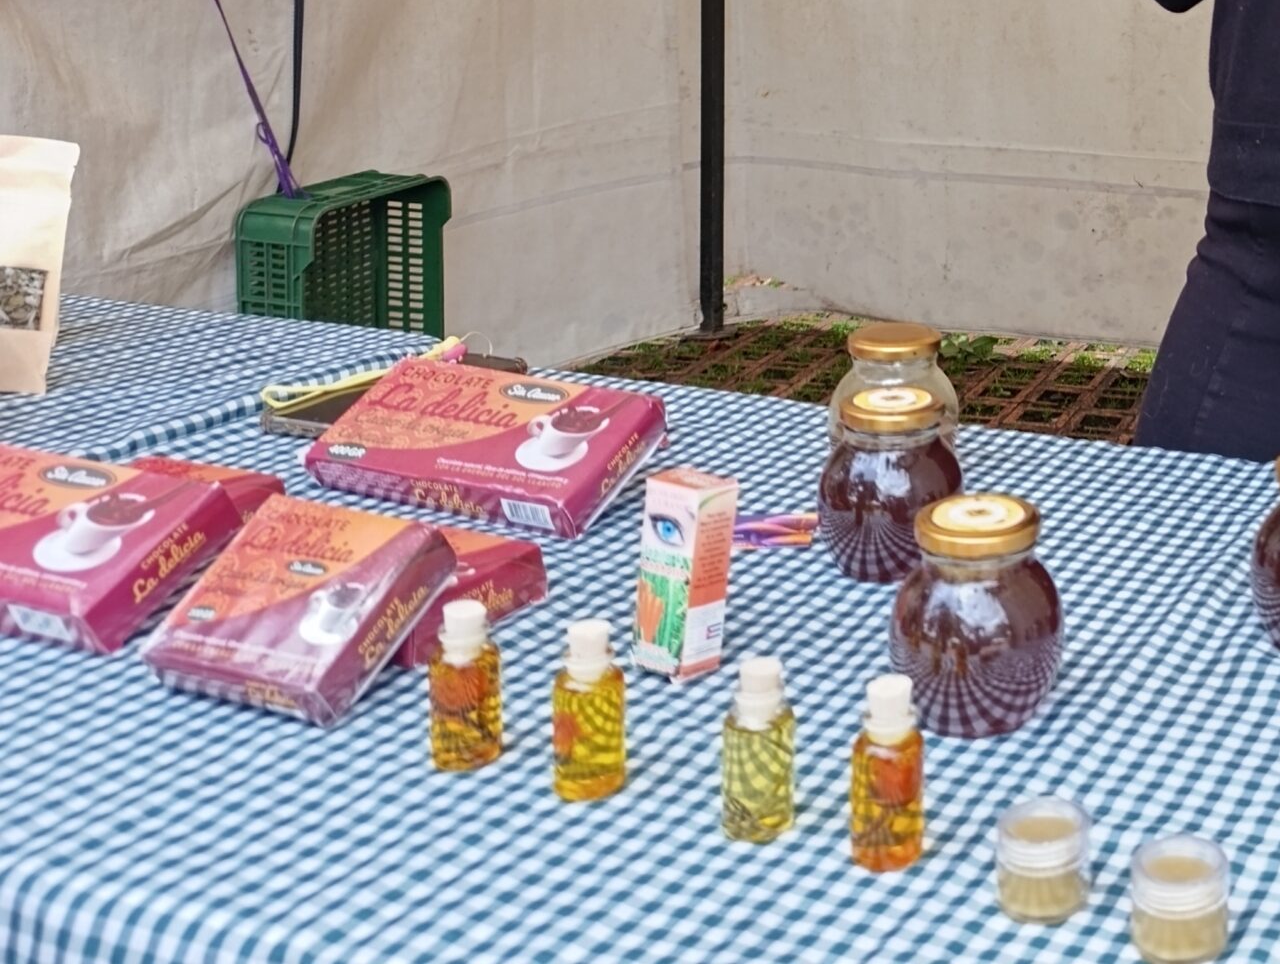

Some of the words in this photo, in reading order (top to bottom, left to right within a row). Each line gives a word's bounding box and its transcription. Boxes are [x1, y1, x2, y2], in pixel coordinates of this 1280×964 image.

[402, 366, 494, 389] CHOCOLATE
[368, 382, 418, 412] La
[420, 387, 518, 429] delicia
[607, 432, 640, 470] CHOCOLATE
[410, 479, 459, 494] CHOCOLATE
[132, 577, 159, 605] La
[158, 531, 207, 579] delicia
[141, 523, 189, 570] CHOCOLATE
[358, 597, 400, 655] CHOCOLATE
